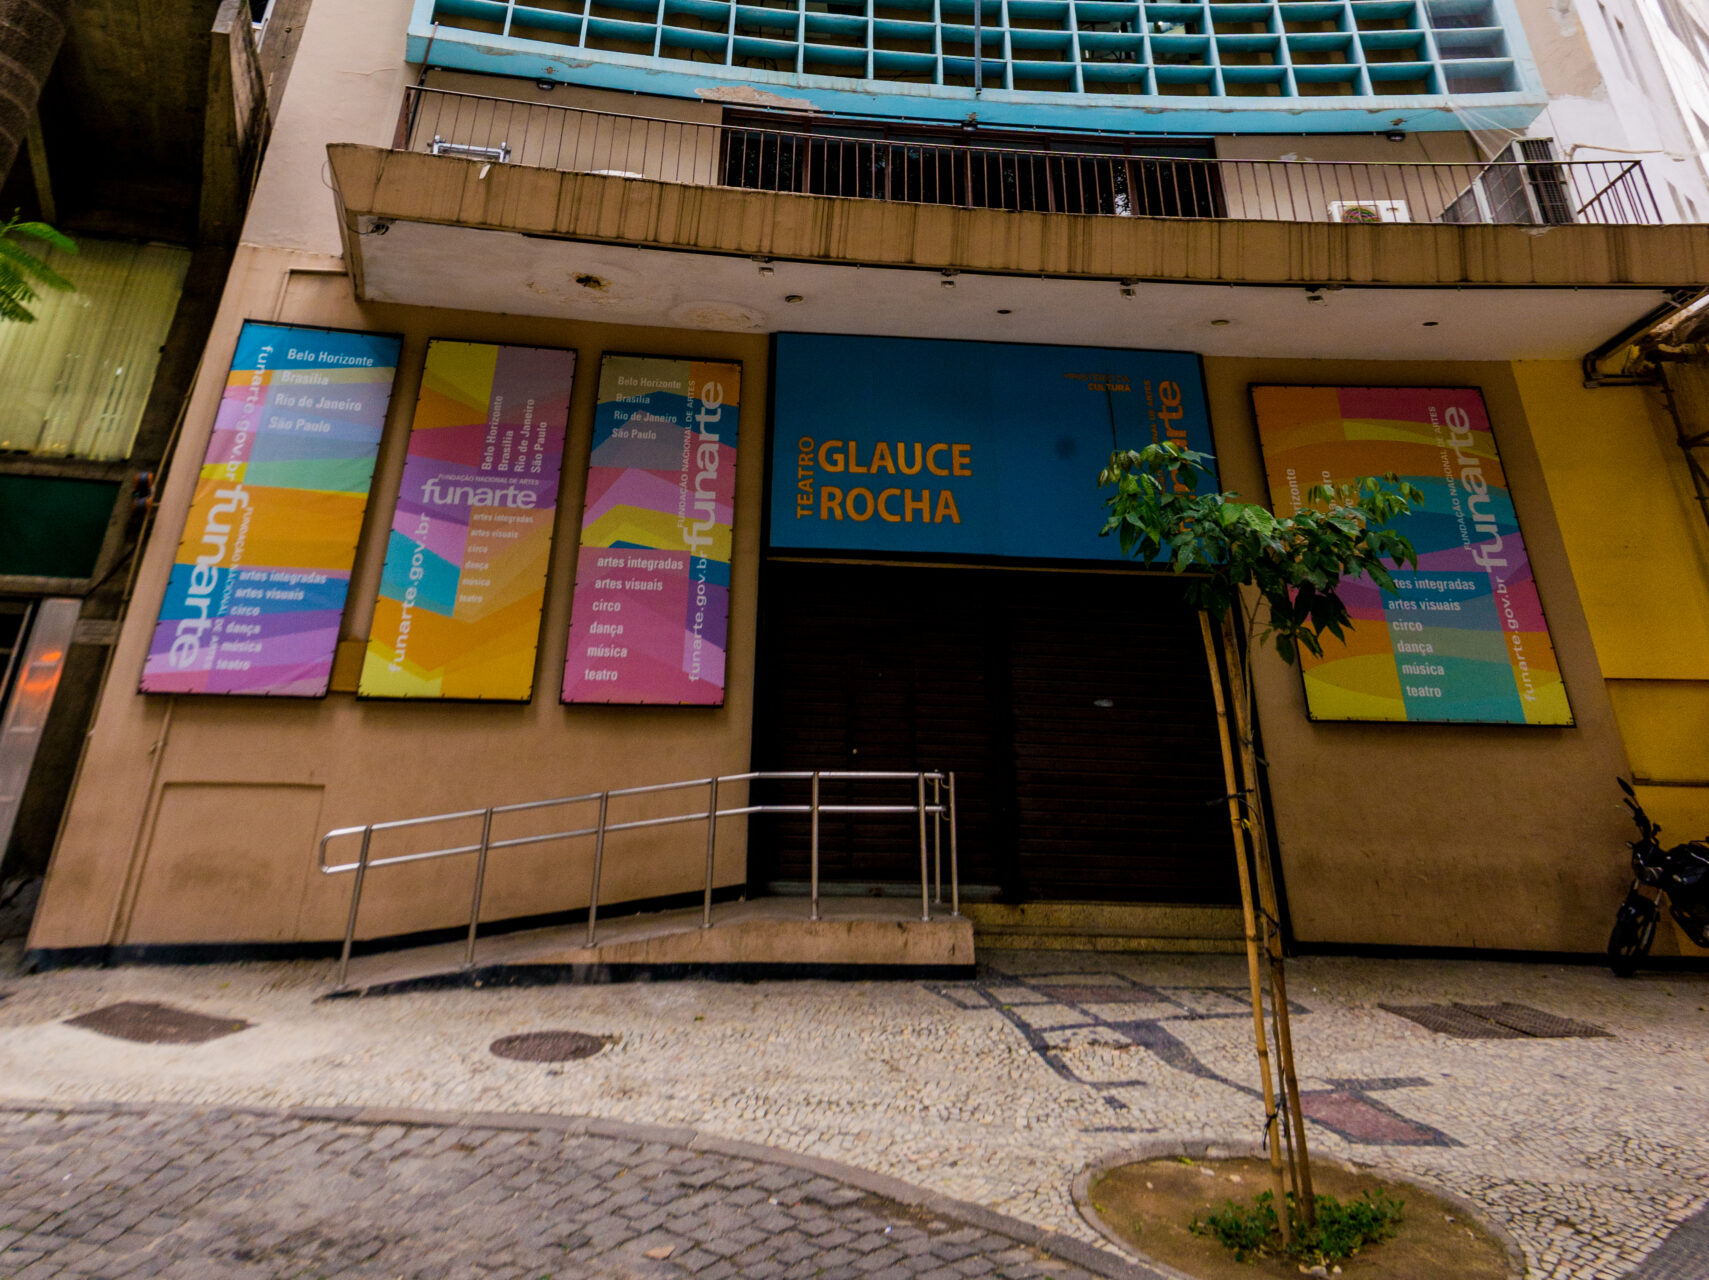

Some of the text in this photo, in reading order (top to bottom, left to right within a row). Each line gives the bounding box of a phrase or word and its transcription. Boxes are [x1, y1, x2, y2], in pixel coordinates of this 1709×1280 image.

[287, 348, 374, 366] Belo Horizonte
[618, 376, 681, 389] Belo Horizonte
[1087, 382, 1132, 392] CULTURA
[275, 393, 362, 411] Rio de Janeiro
[225, 345, 273, 482] funarte.gov.br
[614, 410, 677, 423] Rio de Janeiro
[1428, 406, 1442, 434] ARTES
[268, 416, 331, 432] São Paulo
[481, 395, 503, 471] Belo Horizonte
[514, 399, 535, 473] Rio de Janeiro
[612, 428, 657, 439] São Paulo
[530, 422, 548, 473] São Paulo
[678, 380, 696, 527] FUNDAÇÃO NACIONAL DE ARTES
[683, 381, 723, 551] funarte
[818, 440, 972, 477] GLAUCE
[797, 436, 815, 519] TEATRO
[1440, 449, 1458, 496] NACIONAL
[421, 478, 537, 509] funarte
[1444, 406, 1508, 573] funarte
[820, 486, 961, 524] ROCHA
[1452, 498, 1472, 551] FUNDAÇÃO
[597, 555, 684, 571] artes integradas
[169, 484, 250, 668] funarte
[239, 570, 328, 585] artes integradas
[595, 577, 663, 591] artes visuais
[388, 512, 431, 672] funarte.gov.br
[1393, 577, 1476, 592] tes integradas
[235, 587, 305, 600] artes visuais
[230, 604, 261, 616] circo
[592, 598, 621, 611] circo
[1388, 598, 1461, 611] artes visuais
[688, 550, 708, 682] funarte.gov.br
[226, 621, 261, 636] dança
[589, 621, 623, 637] dança
[1392, 619, 1423, 631] circo
[1495, 575, 1537, 702] funarte.gov.br
[587, 643, 628, 658] música
[1397, 640, 1434, 656] dança
[584, 668, 618, 680] teatro
[1402, 662, 1445, 675] música
[1406, 685, 1442, 697] teatro
